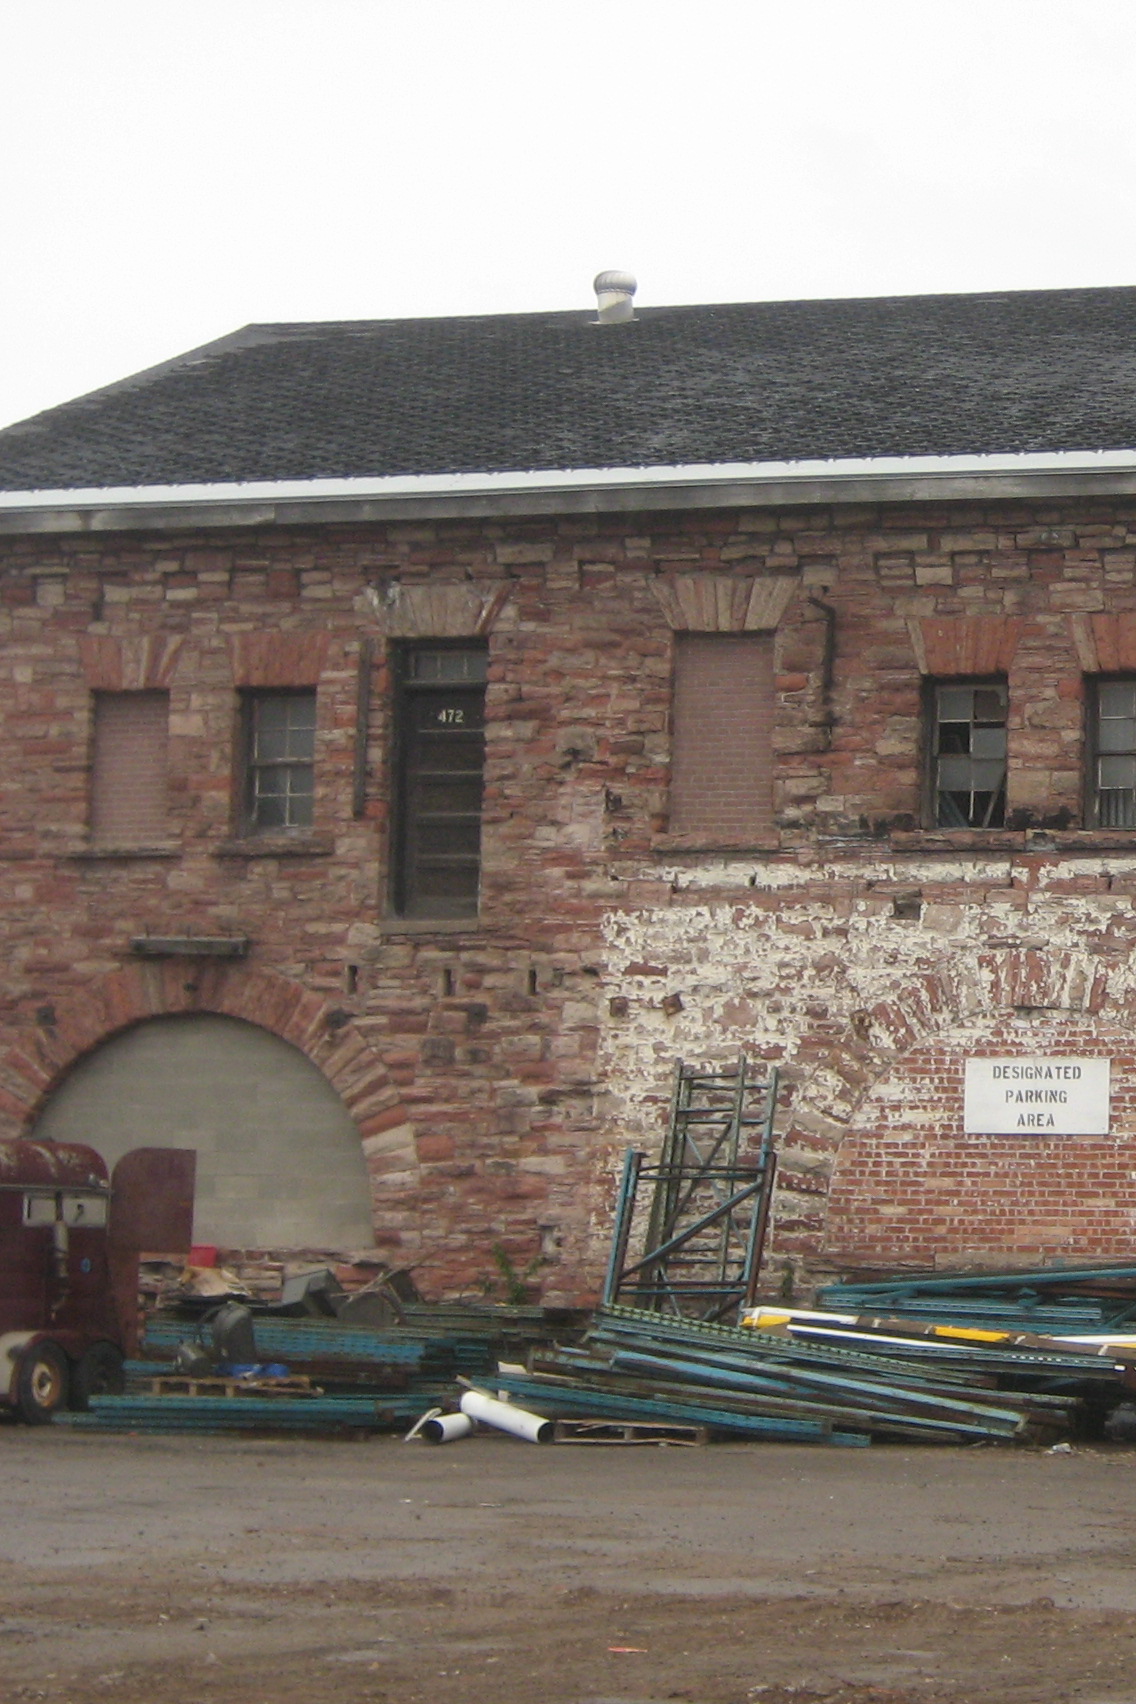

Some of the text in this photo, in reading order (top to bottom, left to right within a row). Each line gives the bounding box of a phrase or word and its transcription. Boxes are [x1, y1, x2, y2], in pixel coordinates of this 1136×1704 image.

[437, 709, 464, 723] 472
[992, 1065, 1081, 1080] DESIGNATED
[1005, 1089, 1068, 1103] PARKING
[1016, 1113, 1055, 1127] AREA
